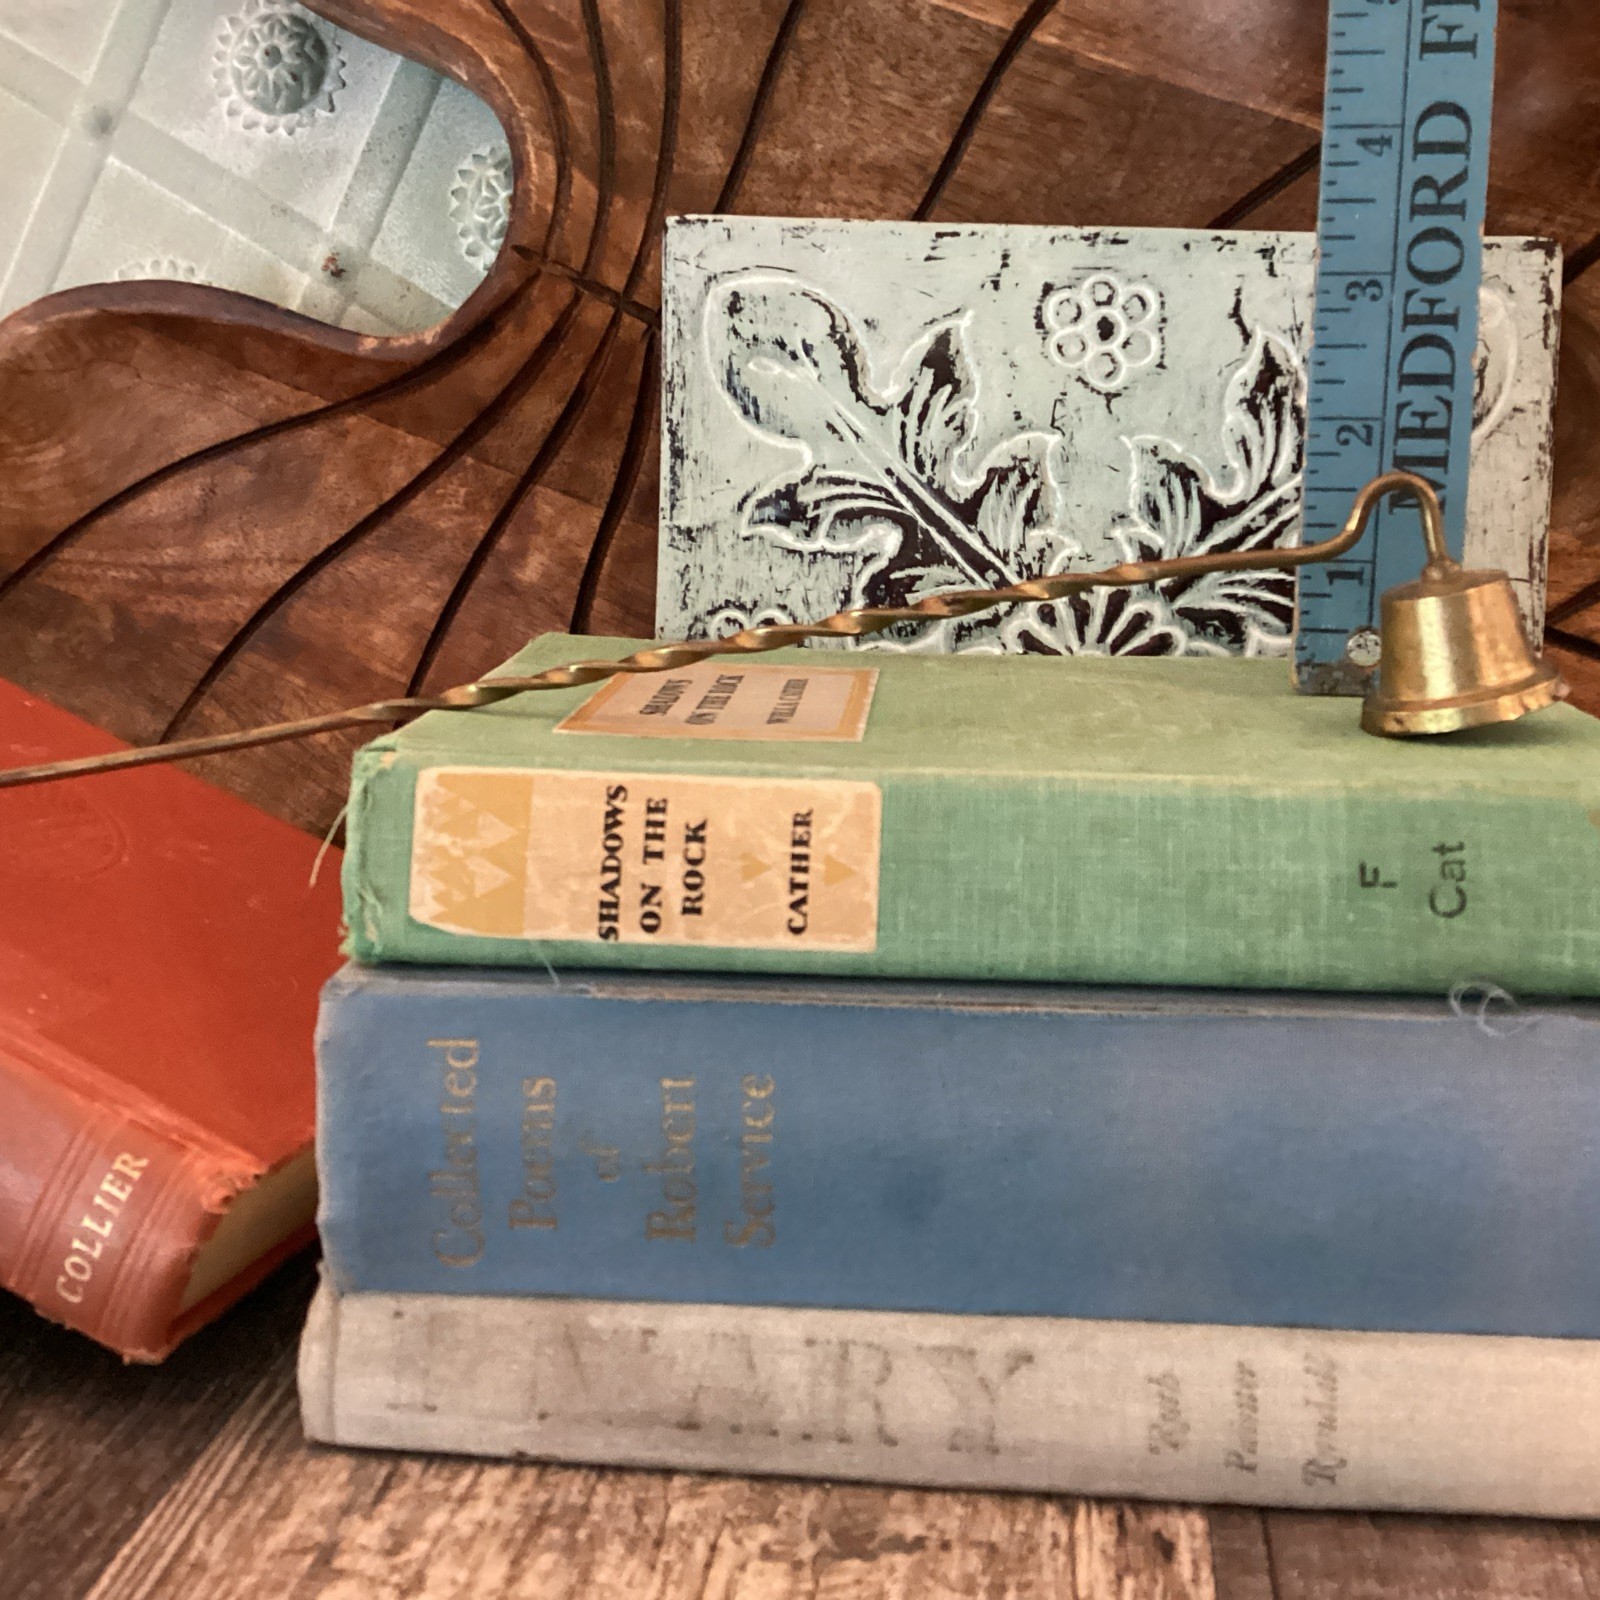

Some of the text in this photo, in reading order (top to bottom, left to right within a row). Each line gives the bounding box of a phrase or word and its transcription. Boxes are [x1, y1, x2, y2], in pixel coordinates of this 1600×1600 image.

[1356, 134, 1393, 157] 4
[1345, 279, 1383, 302] 3
[1389, 101, 1473, 516] MEDFORD
[1336, 424, 1375, 448] 2
[1326, 569, 1364, 587] 1
[598, 784, 628, 942] SHADOWS
[640, 797, 668, 934] ON THE
[680, 818, 708, 917] ROCK
[787, 807, 814, 935] CATHER
[1358, 860, 1398, 889] F
[1429, 841, 1468, 919] Cat
[426, 1038, 486, 1268] Collected
[508, 1075, 558, 1231] Poems
[642, 1076, 698, 1243] Robert
[723, 1073, 776, 1249] Service
[56, 1152, 149, 1304] COLLIER
